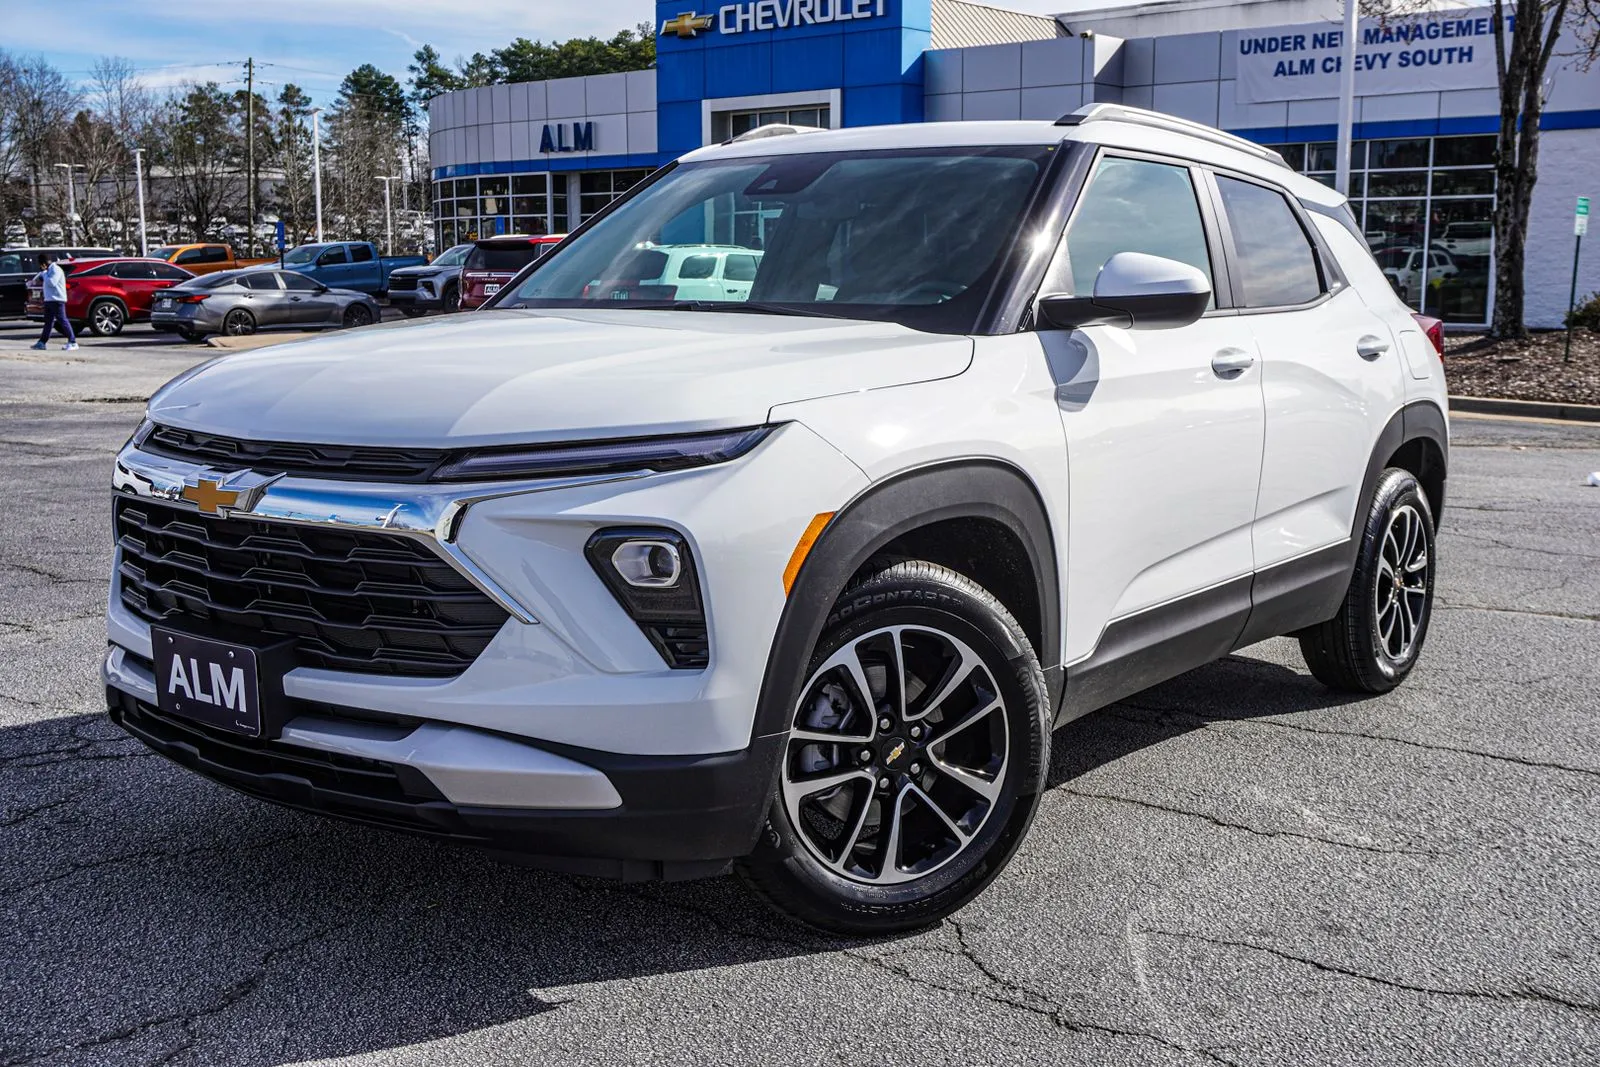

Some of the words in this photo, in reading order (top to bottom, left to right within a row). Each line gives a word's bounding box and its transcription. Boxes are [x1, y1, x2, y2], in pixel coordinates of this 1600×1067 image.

[1239, 34, 1306, 55] UNDER
[1312, 31, 1344, 50] NE
[1363, 15, 1516, 46] MANAGEMET
[1273, 58, 1315, 77] ALM
[1397, 46, 1474, 69] SOUTH
[539, 121, 594, 153] ALM
[168, 653, 247, 713] ALM
